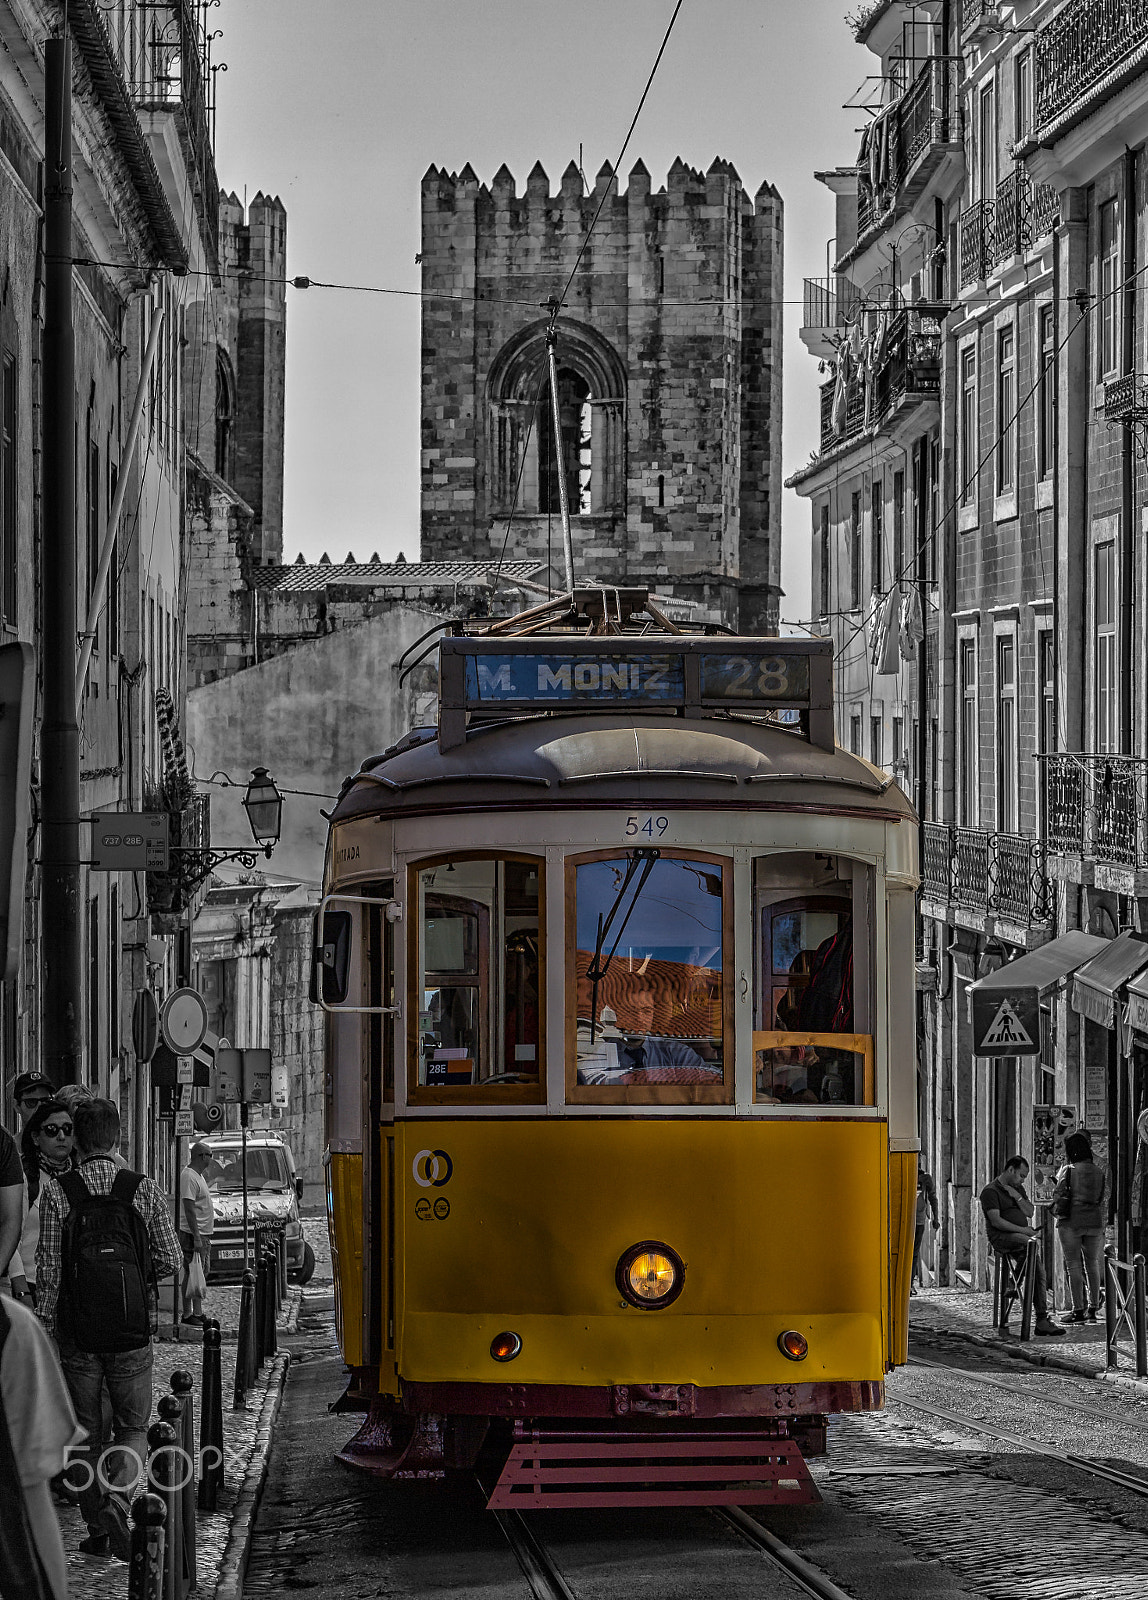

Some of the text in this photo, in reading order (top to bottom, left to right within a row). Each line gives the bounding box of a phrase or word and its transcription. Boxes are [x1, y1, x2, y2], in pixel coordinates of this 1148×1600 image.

[476, 662, 670, 691] M. MONIZ
[724, 656, 788, 697] 28
[625, 816, 669, 837] 549
[104, 837, 142, 845] 737 28E
[429, 1064, 447, 1074] 28E
